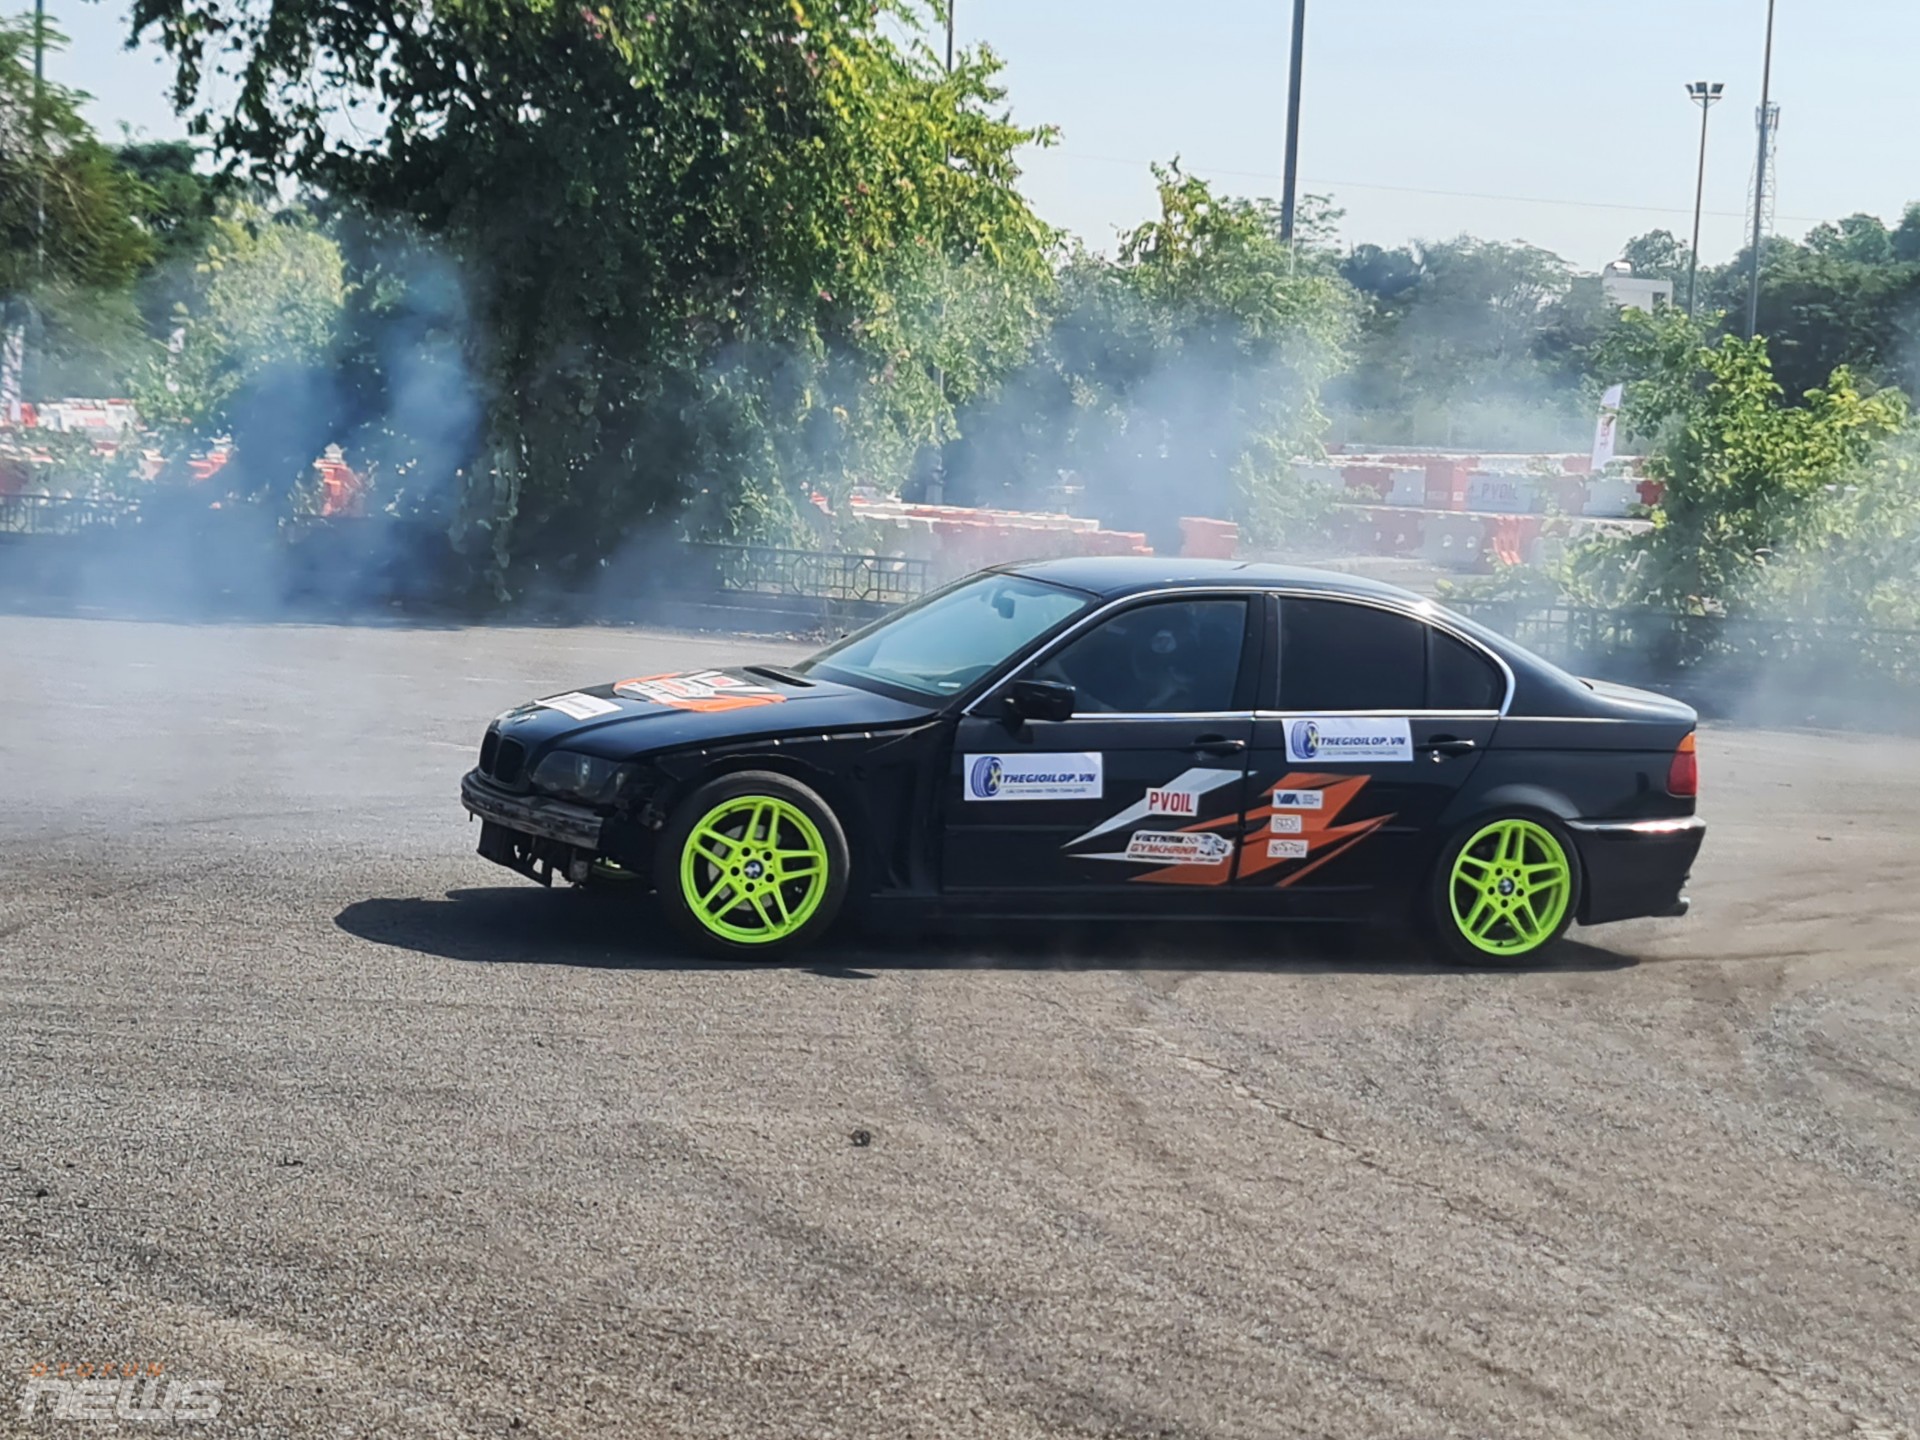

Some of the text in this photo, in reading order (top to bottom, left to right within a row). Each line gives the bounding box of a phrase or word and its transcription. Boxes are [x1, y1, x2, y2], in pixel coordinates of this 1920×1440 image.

[1148, 791, 1193, 812] PVOIL
[1135, 834, 1184, 843] VIETNAM
[1130, 843, 1198, 854] GYMKHANA
